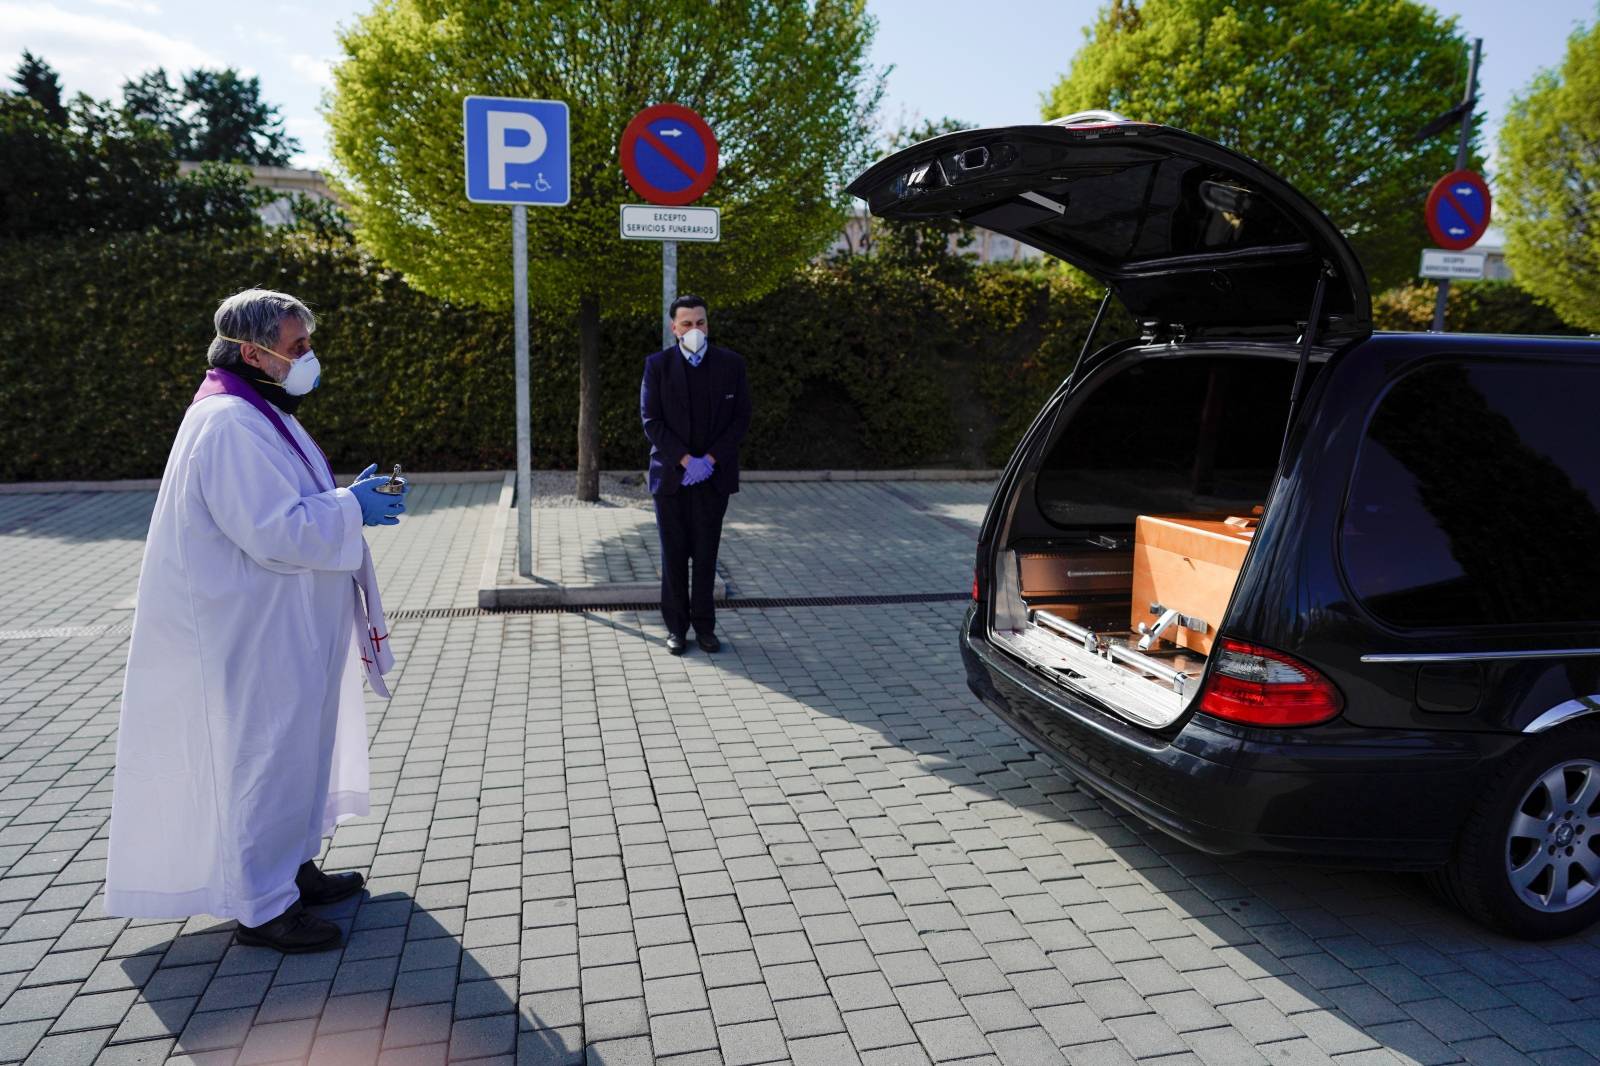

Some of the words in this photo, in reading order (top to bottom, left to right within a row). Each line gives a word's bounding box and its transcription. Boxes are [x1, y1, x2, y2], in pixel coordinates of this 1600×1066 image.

[487, 110, 547, 190] P
[654, 213, 687, 222] EXCEPTO
[626, 223, 666, 232] SERVICIOS
[668, 225, 714, 234] FUNERARIOS
